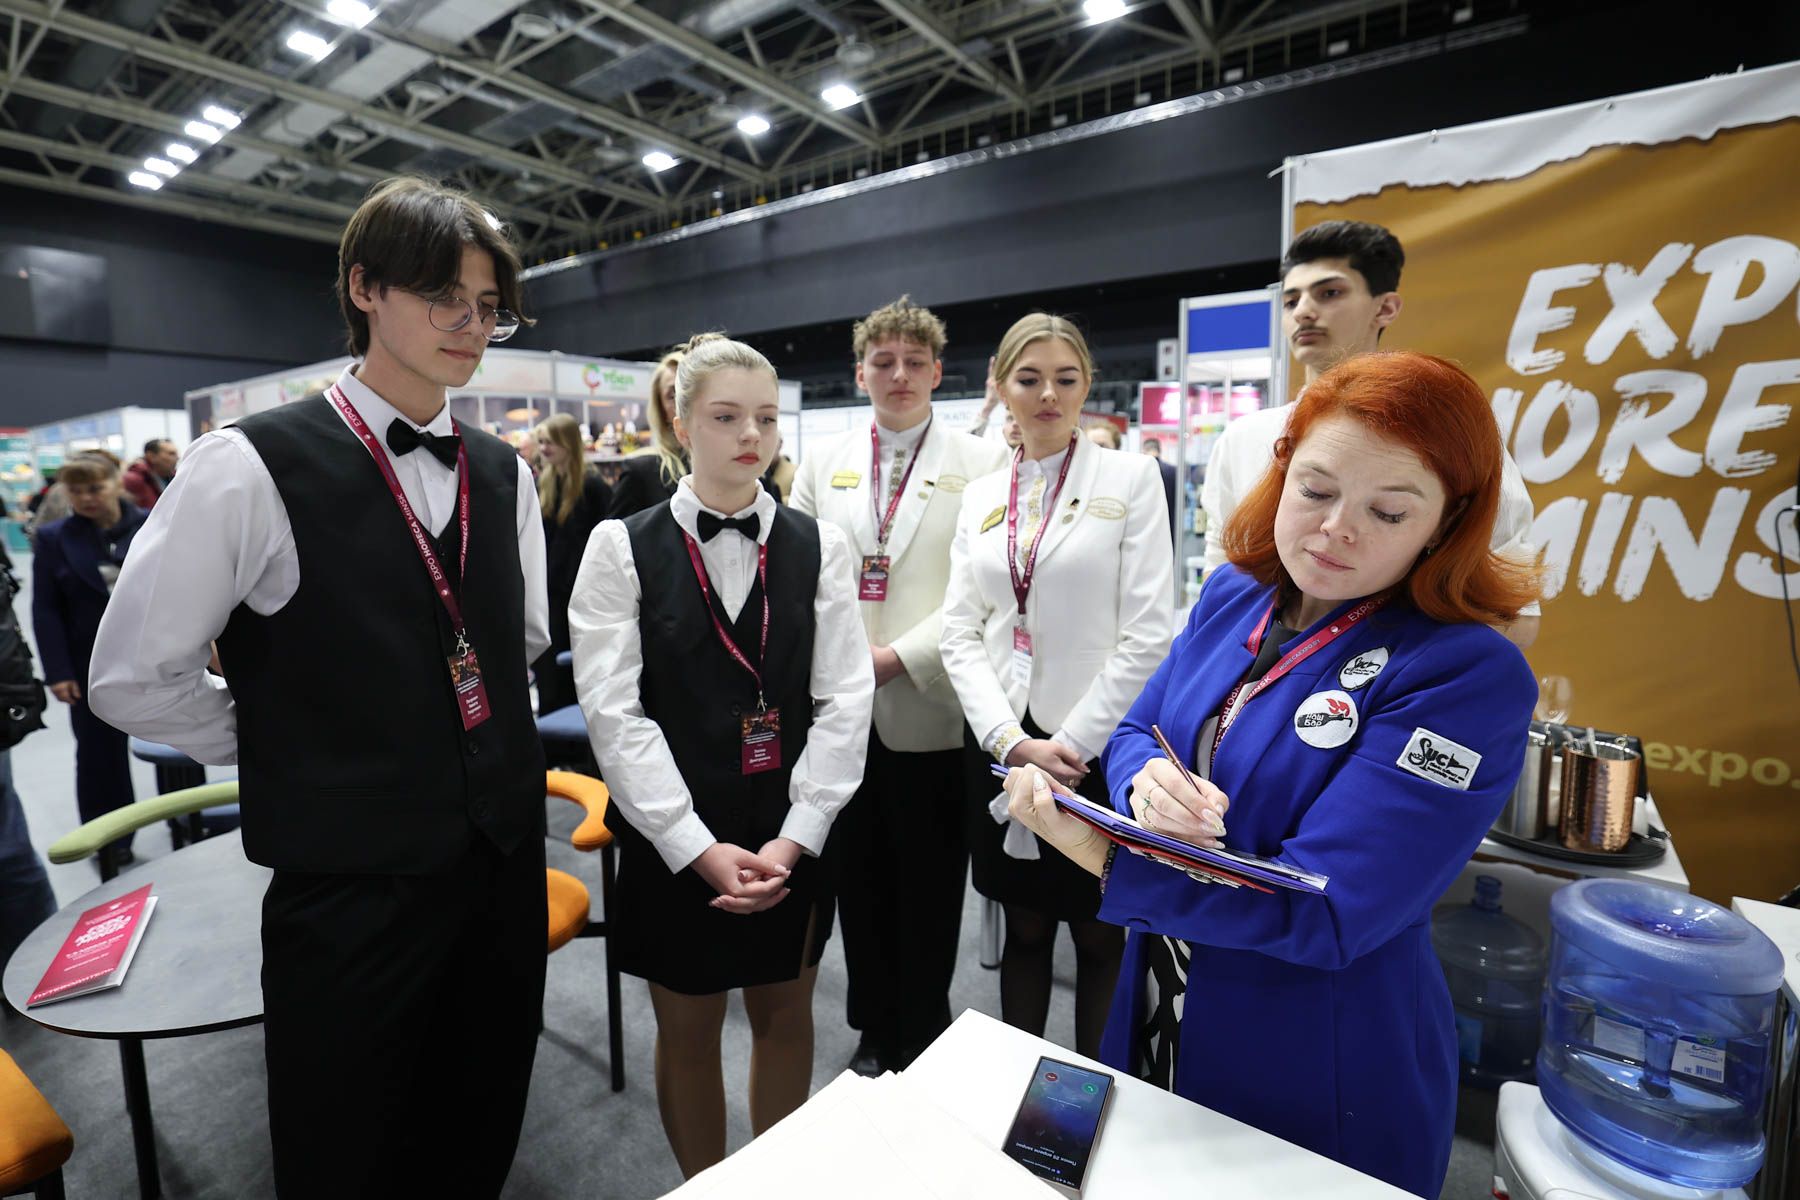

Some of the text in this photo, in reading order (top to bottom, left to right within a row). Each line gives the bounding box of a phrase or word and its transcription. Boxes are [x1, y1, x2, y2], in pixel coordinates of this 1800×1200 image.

[1506, 234, 1800, 375] EXP
[345, 407, 361, 427] EXPO
[1491, 359, 1800, 484] ORE
[396, 494, 442, 581] EXPO HORECA MINSK
[1348, 600, 1375, 621] EXPO
